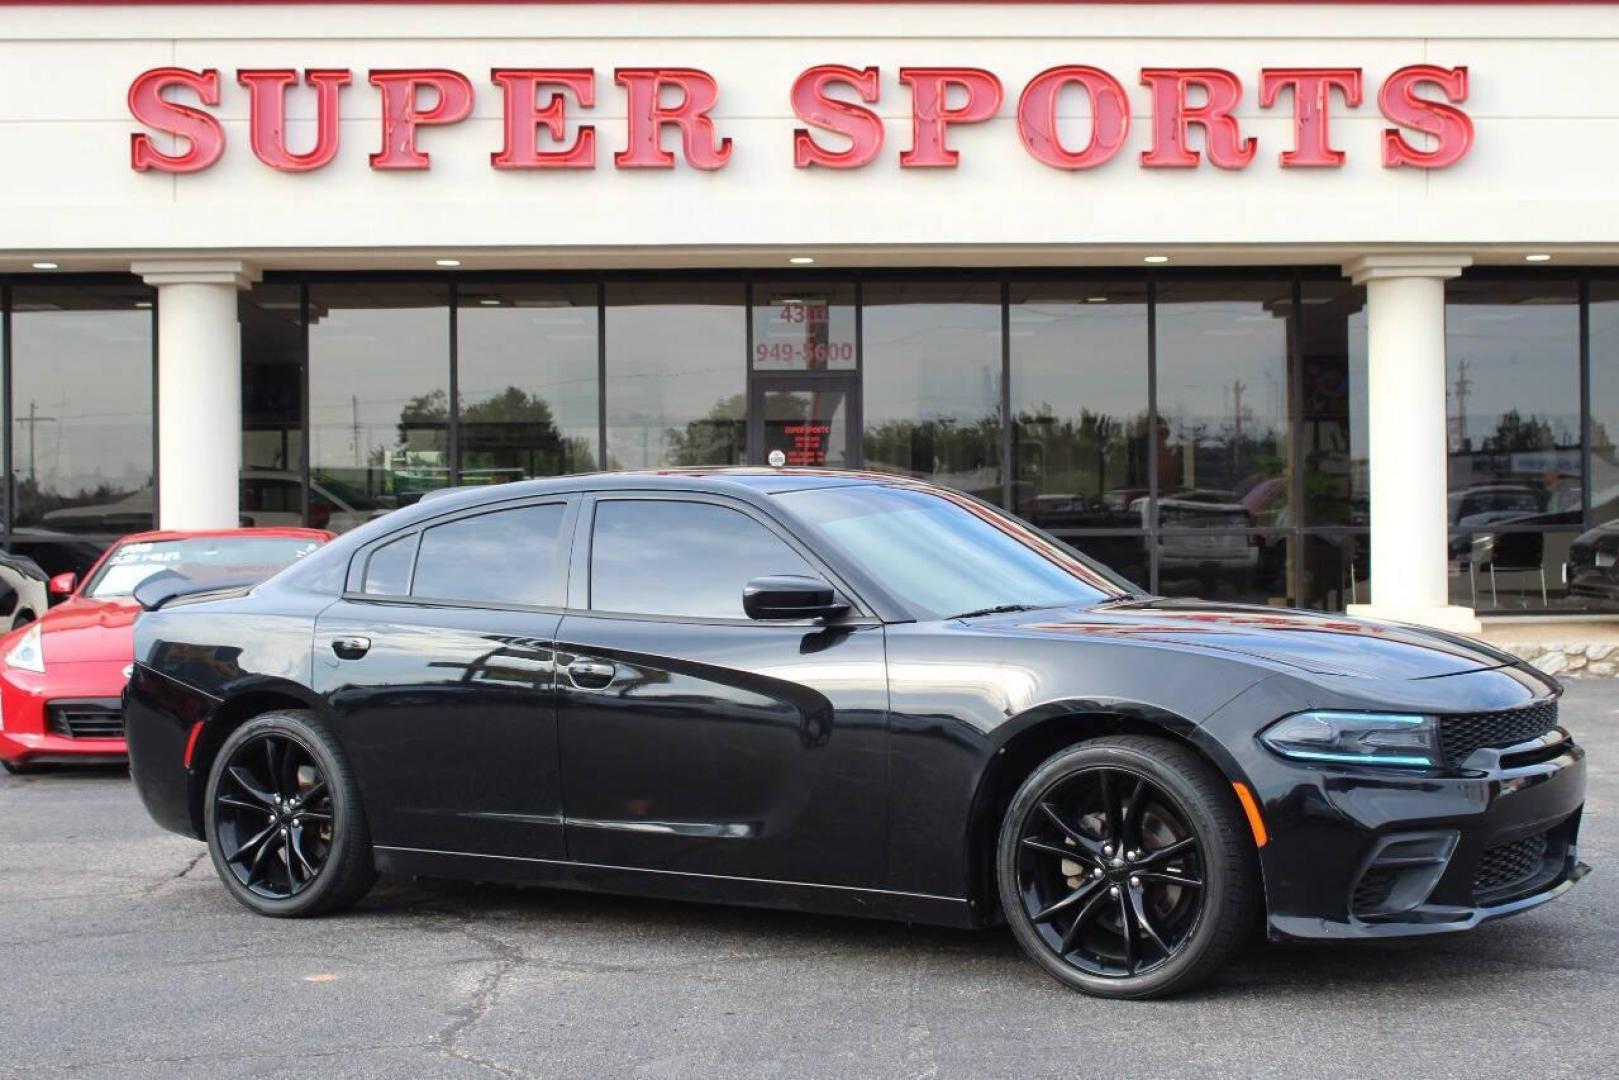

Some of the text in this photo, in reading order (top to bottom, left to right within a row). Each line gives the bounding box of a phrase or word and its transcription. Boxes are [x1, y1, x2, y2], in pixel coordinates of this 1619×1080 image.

[128, 64, 1475, 173] SUPER SPORTS
[756, 343, 853, 361] 949-5600
